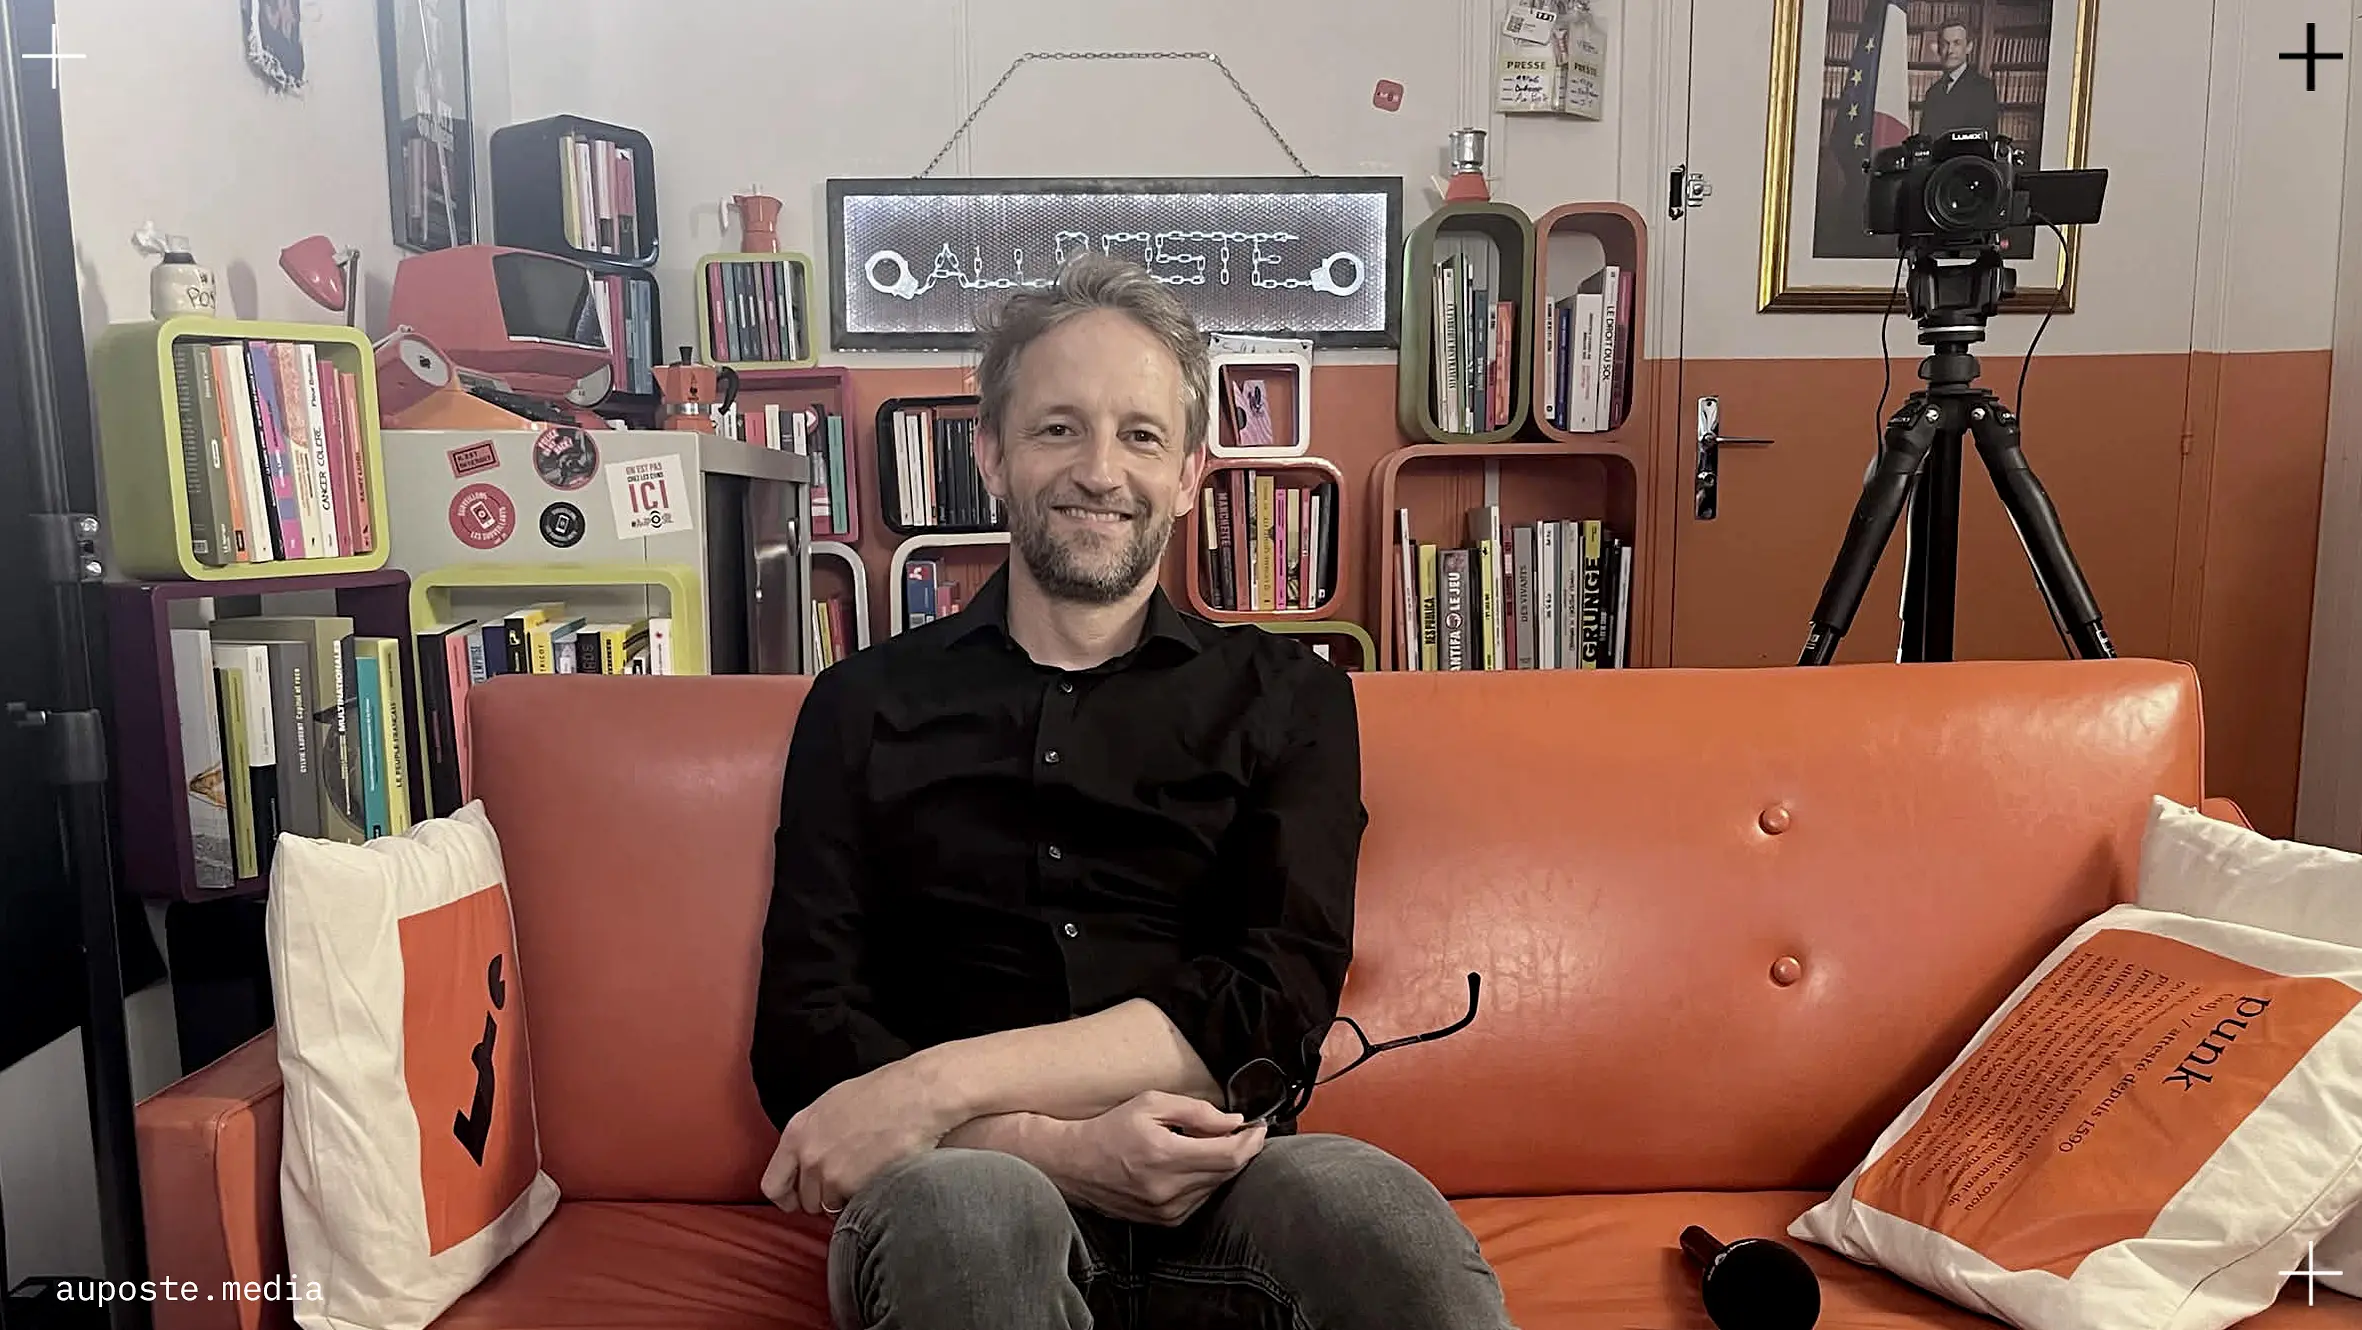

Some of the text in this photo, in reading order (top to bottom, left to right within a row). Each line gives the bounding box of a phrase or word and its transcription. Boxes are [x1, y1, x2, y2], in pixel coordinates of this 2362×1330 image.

[1507, 61, 1546, 70] PRESSE
[1607, 305, 1615, 316] LE
[1604, 318, 1615, 347] DROIT
[319, 471, 331, 511] CANCER
[628, 480, 669, 513] ICI
[1448, 572, 1462, 671] ANTIFA LE JEU
[1582, 557, 1600, 662] GRUNGE
[333, 640, 346, 732] MULTINATIONALES
[393, 743, 402, 774] PEUPLE
[2134, 1028, 2179, 1070] attesté
[2163, 994, 2273, 1092] punk
[2091, 1073, 2135, 1116] depuis
[2058, 1119, 2094, 1152] 1590
[1964, 1181, 1997, 1210] voyou
